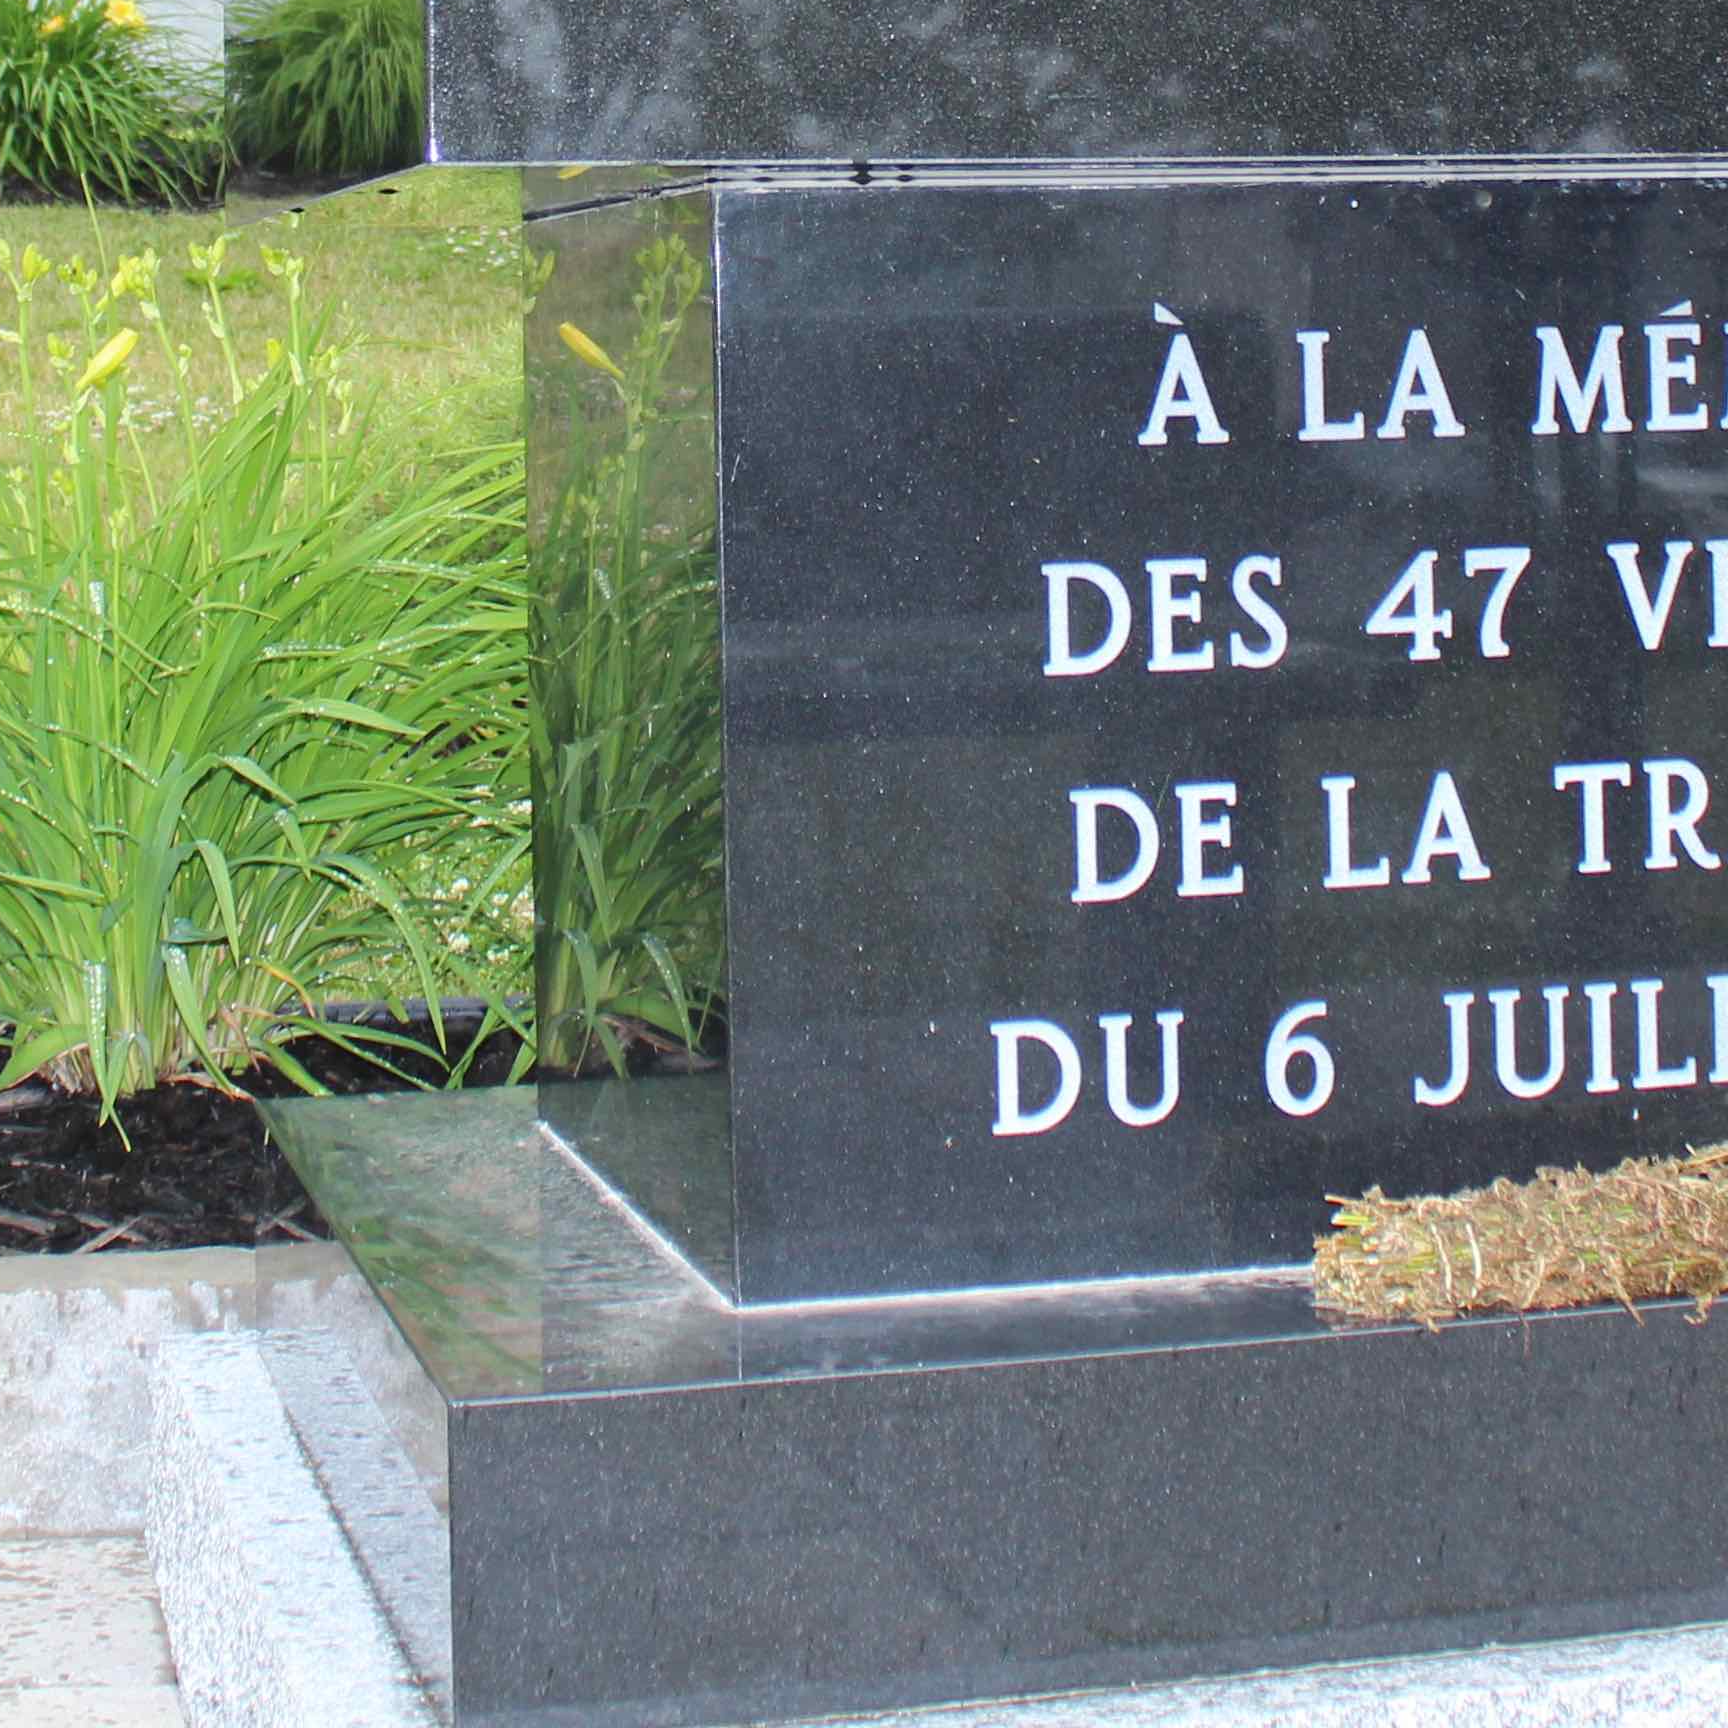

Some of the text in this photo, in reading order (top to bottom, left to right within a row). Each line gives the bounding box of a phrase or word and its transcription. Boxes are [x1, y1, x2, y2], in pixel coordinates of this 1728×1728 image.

[1138, 301, 1229, 445] À
[1296, 328, 1464, 443] LA
[1040, 555, 1290, 677] DES
[1365, 546, 1532, 661] 47
[1069, 781, 1245, 904] DE
[1320, 772, 1492, 893] LA
[989, 1010, 1185, 1137] DU
[1265, 1000, 1336, 1116] 6
